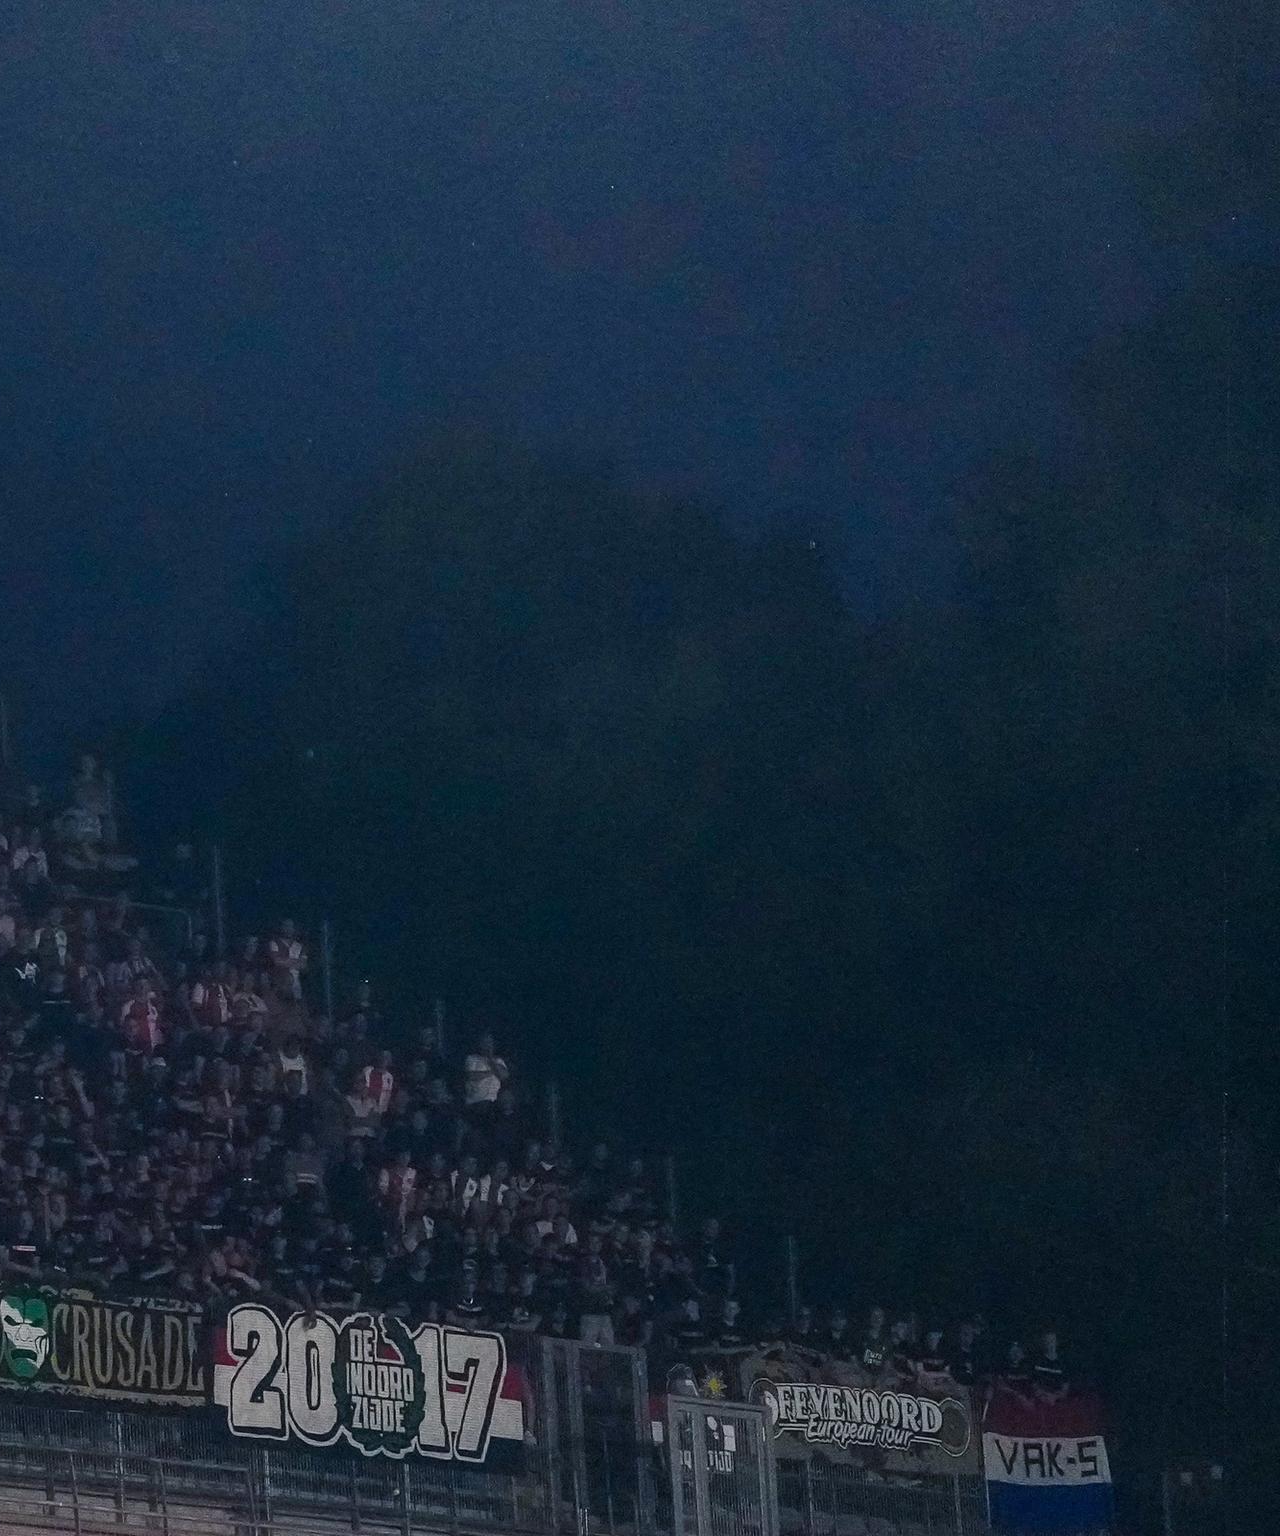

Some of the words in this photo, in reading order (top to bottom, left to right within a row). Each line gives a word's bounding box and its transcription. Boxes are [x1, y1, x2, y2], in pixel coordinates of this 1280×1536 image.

[348, 1327, 376, 1363] DE
[346, 1362, 415, 1402] NOORD
[350, 1396, 406, 1433] ZIJDE
[776, 1385, 943, 1434] FEYENOORD
